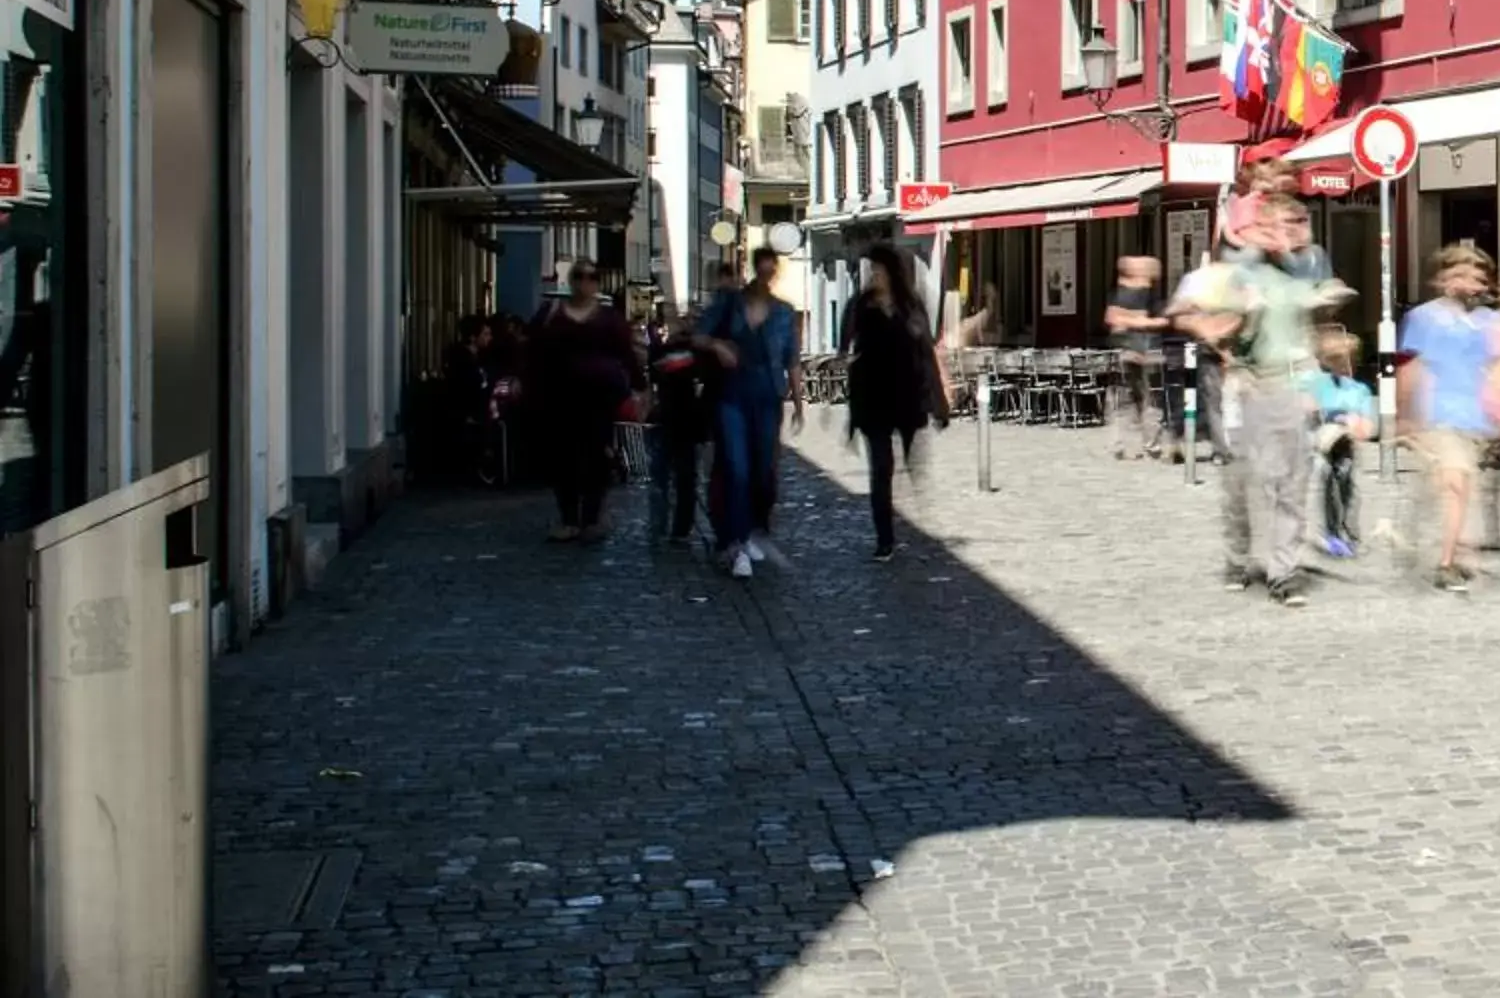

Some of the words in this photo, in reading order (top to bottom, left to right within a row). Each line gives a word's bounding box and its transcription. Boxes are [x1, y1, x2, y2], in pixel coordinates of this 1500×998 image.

[374, 12, 429, 31] Nature
[452, 16, 488, 34] First
[1311, 175, 1350, 191] HOTEL
